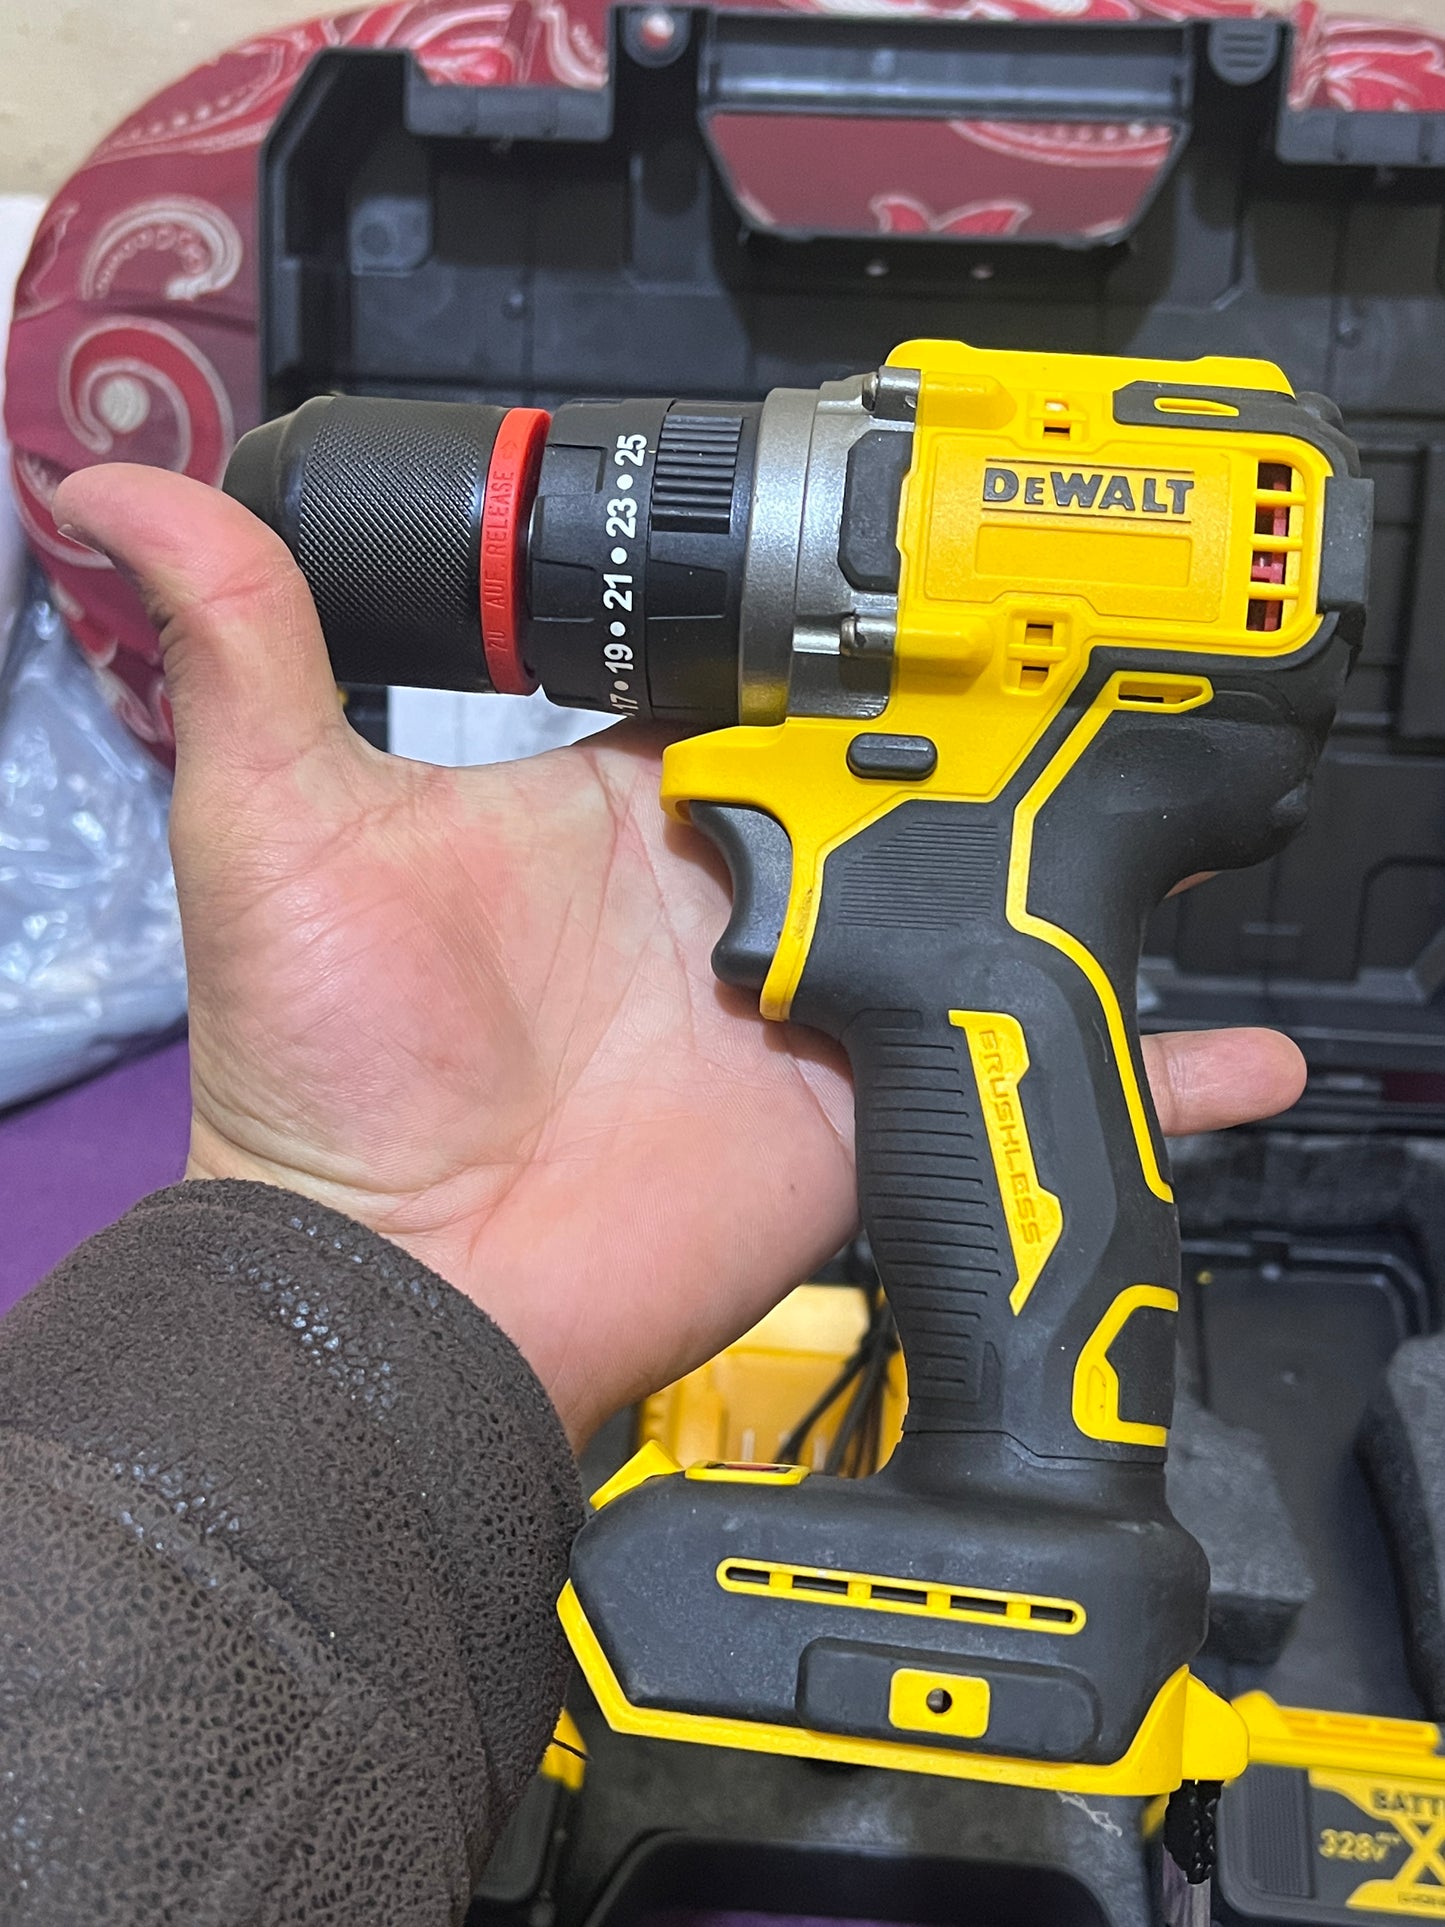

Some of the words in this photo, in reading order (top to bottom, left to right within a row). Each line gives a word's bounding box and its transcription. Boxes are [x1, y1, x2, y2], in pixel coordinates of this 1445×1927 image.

[614, 434, 648, 467] 25
[606, 498, 638, 539] 23
[603, 573, 633, 612] 21
[603, 643, 634, 673] 19
[610, 693, 639, 710] 17
[979, 1029, 1042, 1245] BRUSHLESS
